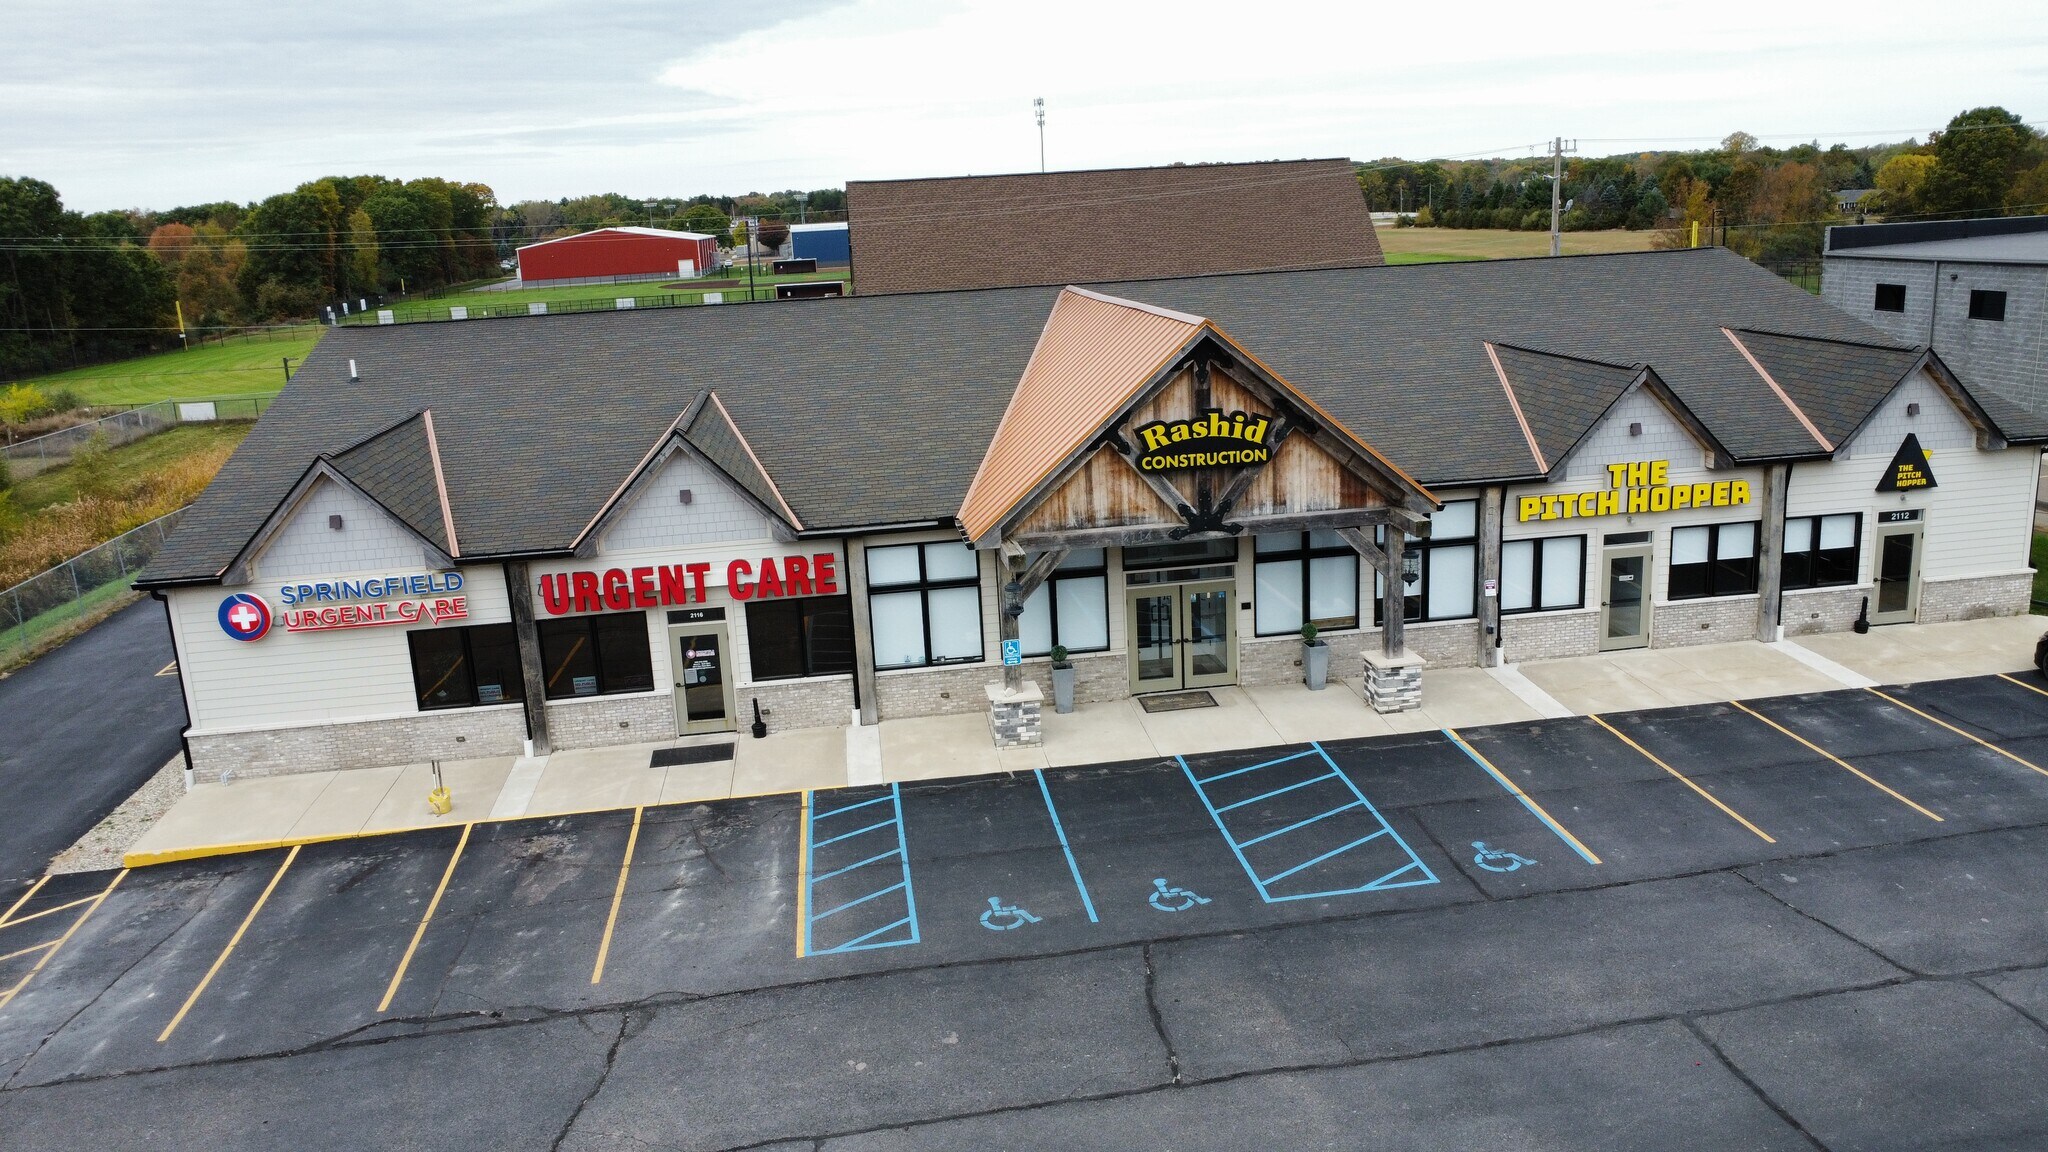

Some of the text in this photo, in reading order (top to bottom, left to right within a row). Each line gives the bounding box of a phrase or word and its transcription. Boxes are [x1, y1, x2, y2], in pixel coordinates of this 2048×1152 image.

[1140, 412, 1270, 452] Rashid
[1142, 448, 1267, 471] CONSTRUCTION
[1607, 460, 1670, 489] THE
[1896, 479, 1926, 487] HOPPER
[1518, 480, 1750, 522] PITCH HOPPER
[1891, 512, 1909, 520] 2112
[280, 572, 464, 605] SPRINGFIELD
[540, 552, 838, 615] URGENT CARE
[283, 597, 468, 628] URGENT CARE
